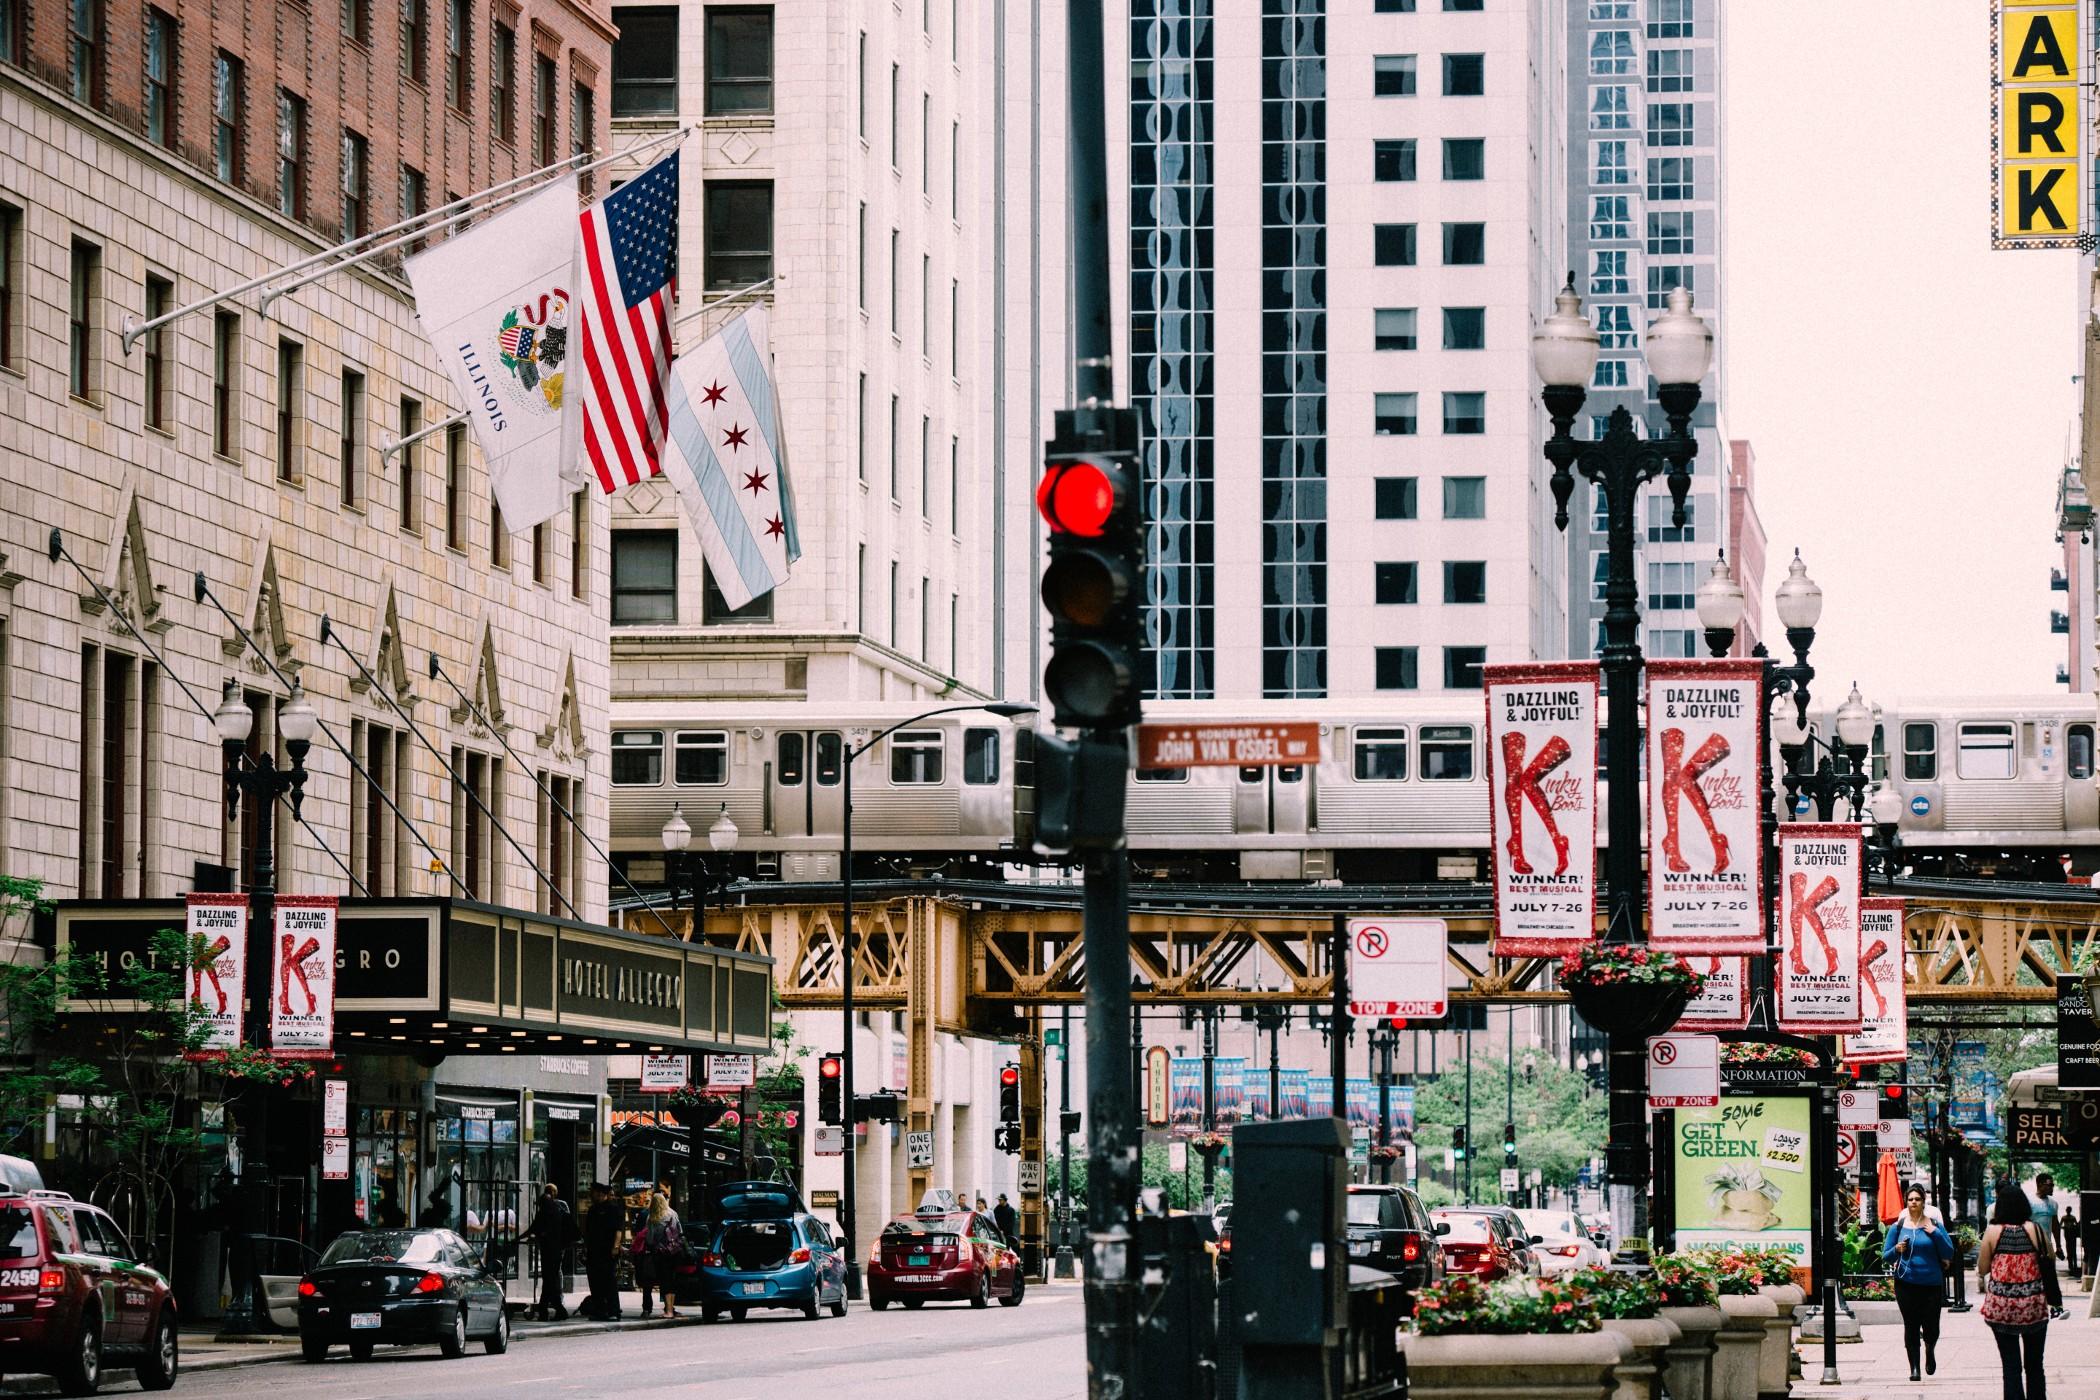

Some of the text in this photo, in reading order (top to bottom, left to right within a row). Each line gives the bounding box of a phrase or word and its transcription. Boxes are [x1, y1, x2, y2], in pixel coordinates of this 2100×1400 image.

[2012, 15, 2070, 231] ARK
[458, 343, 508, 432] ILLINOIS
[1506, 708, 1517, 721] &
[1666, 704, 1676, 718] &
[1196, 728, 1260, 739] HONORARY
[1155, 740, 1194, 762] JOHN
[1201, 740, 1230, 761] VAN
[1235, 738, 1283, 760] OSDEL
[1912, 801, 1928, 810] cta
[1794, 856, 1802, 866] &
[1509, 875, 1583, 884] WINNER!
[1664, 873, 1747, 882] WINNER!
[1510, 885, 1584, 893] BEST MUSICAL
[1510, 903, 1547, 912] JULY
[1664, 902, 1706, 911] JULY
[197, 919, 203, 928] &
[1862, 914, 1893, 923] ZZLING
[285, 921, 291, 929] &
[564, 958, 681, 1010] HOTEL ALLEGRO
[1356, 1002, 1436, 1014] TOW ZONE
[2058, 1000, 2090, 1008] RANDO
[2063, 1008, 2093, 1016] TAVER
[540, 1055, 589, 1075] STARBUCKS COFFEE
[1720, 1070, 1806, 1081] NFORMATION
[1653, 1096, 1713, 1106] TOW ZONE
[461, 1106, 495, 1119] STARBUCKS COFFEE
[549, 1107, 580, 1120] STARBUCKS COFFEE
[1722, 1102, 1764, 1122] SOME
[1681, 1122, 1726, 1140] GET
[909, 1134, 930, 1143] ONE
[1773, 1133, 1801, 1146] LOANS
[2016, 1130, 2069, 1145] PARK
[910, 1143, 930, 1153] WAY
[1681, 1140, 1761, 1158] GREEN.
[1021, 1161, 1038, 1171] ONE
[1020, 1171, 1038, 1180] WAY
[0, 1269, 40, 1287] 2459
